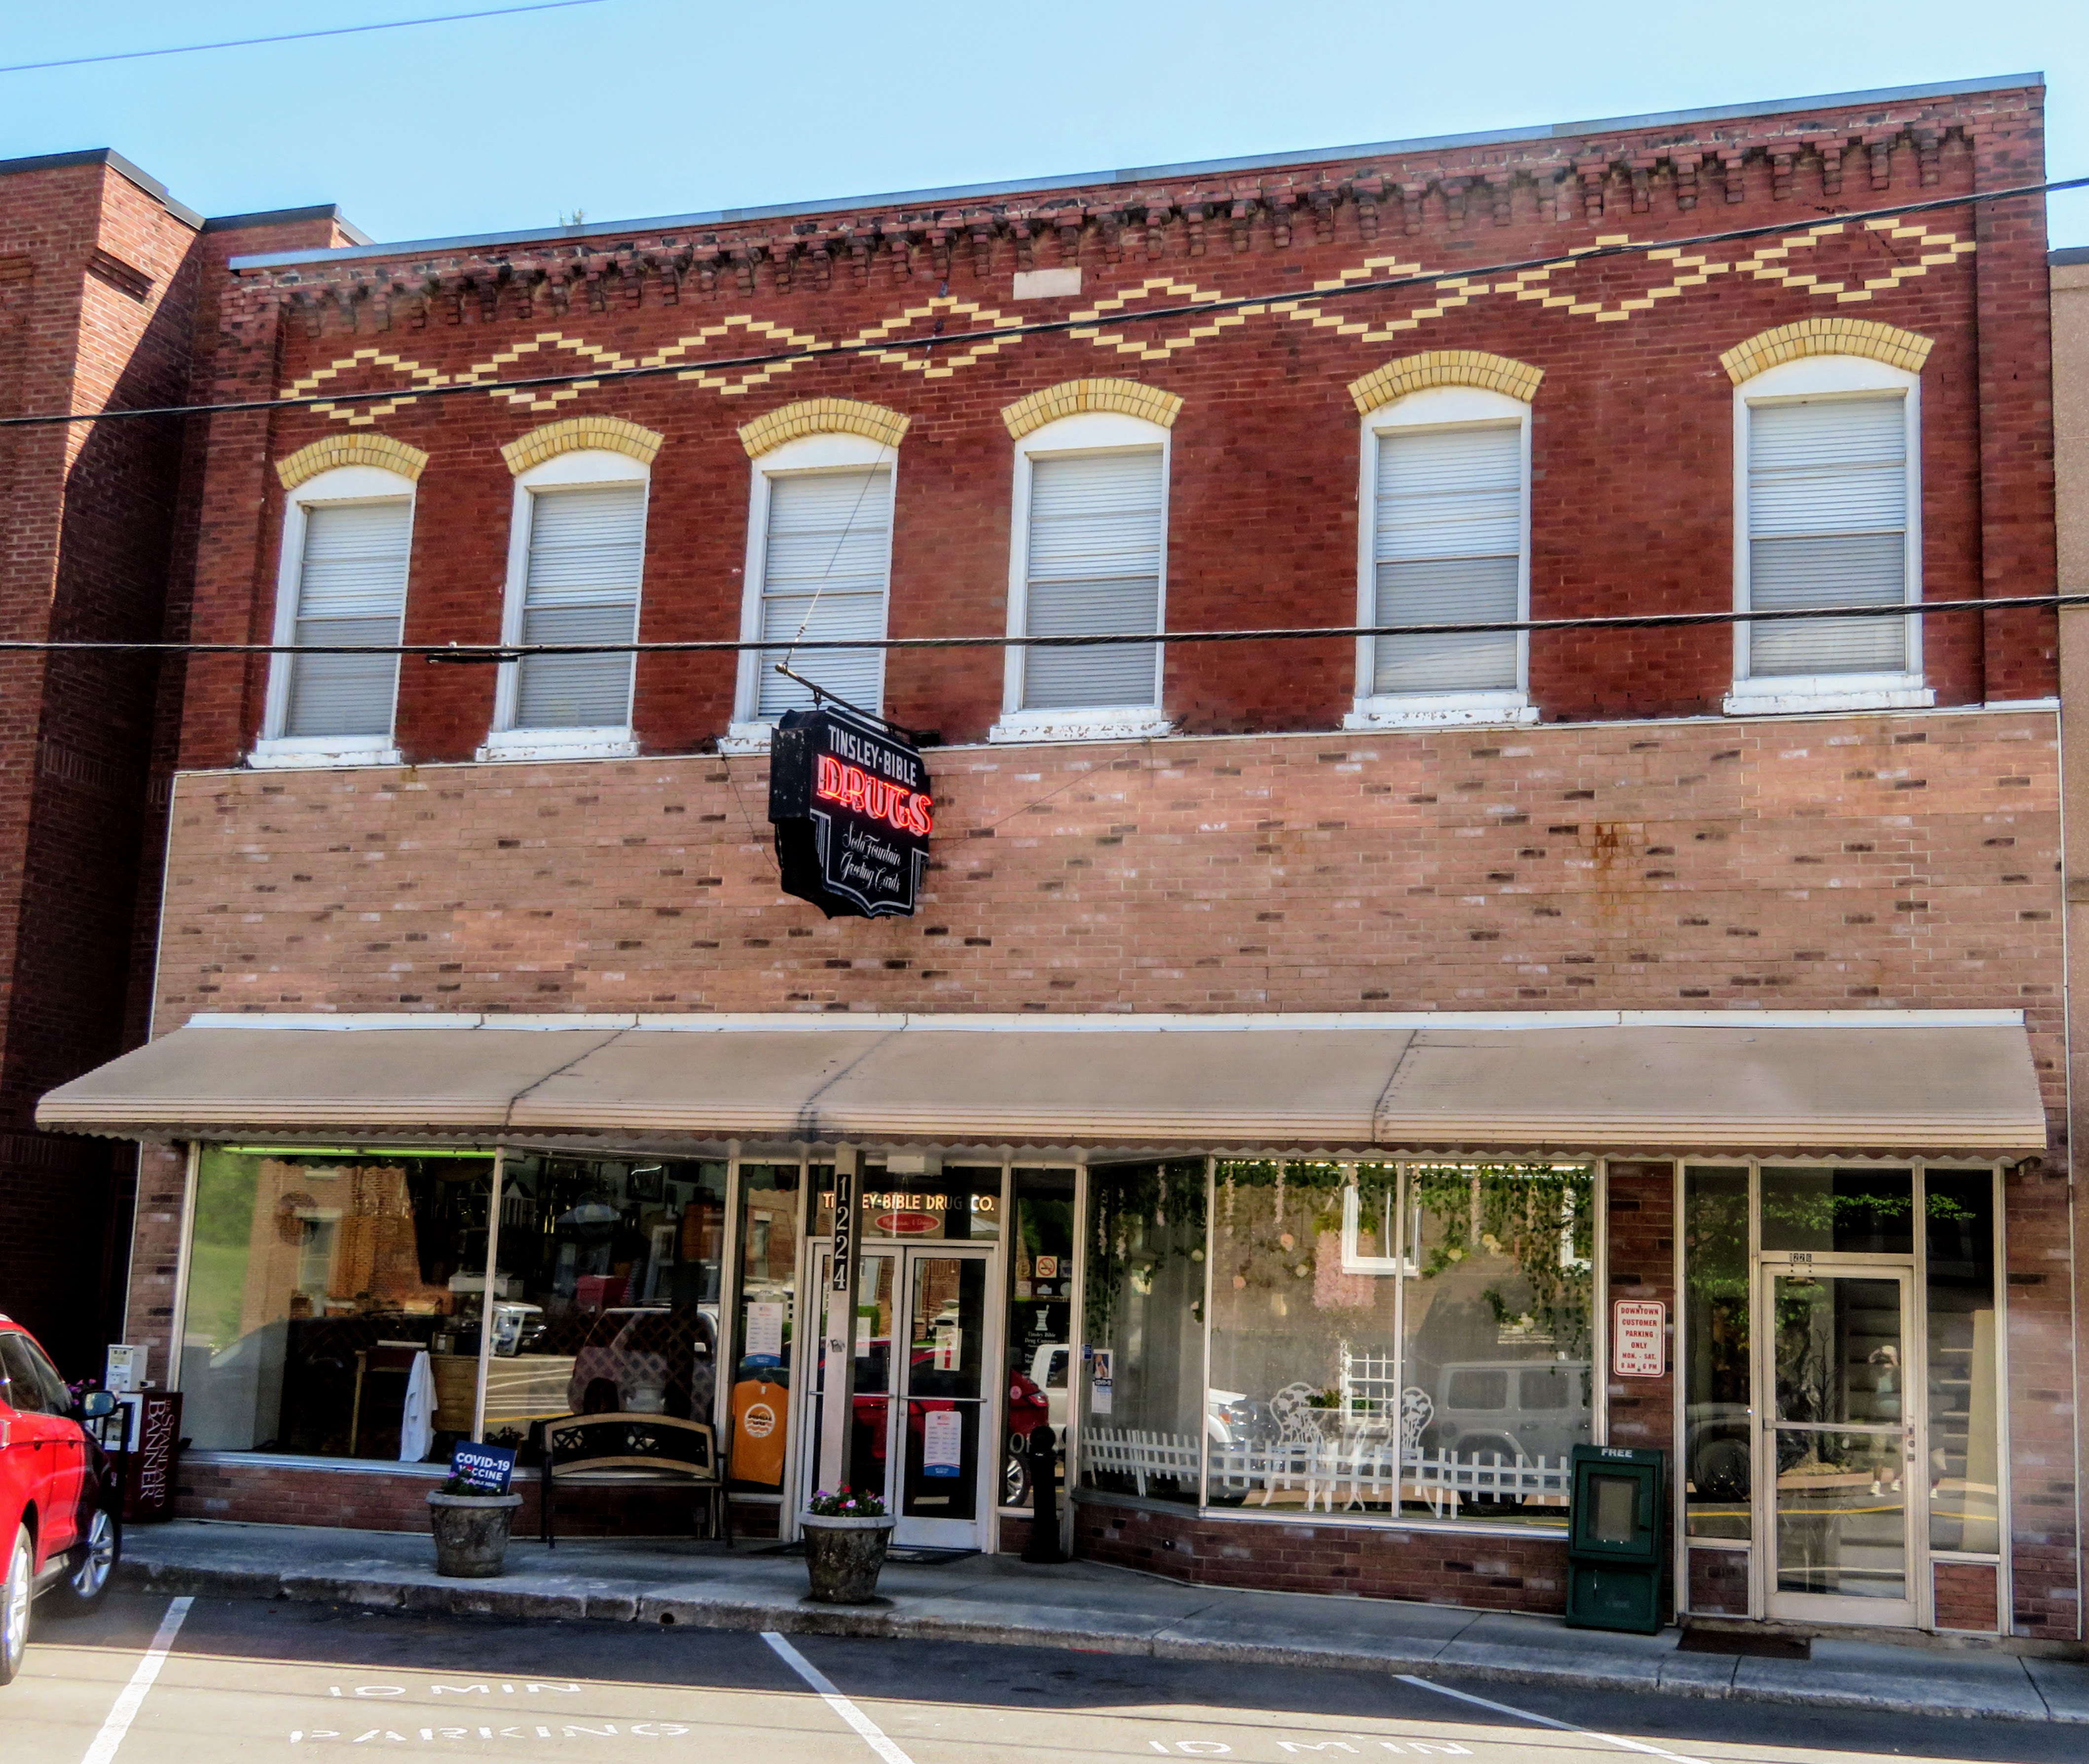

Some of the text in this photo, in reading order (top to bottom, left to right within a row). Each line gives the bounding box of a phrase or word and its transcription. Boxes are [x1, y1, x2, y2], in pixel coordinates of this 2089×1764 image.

[816, 754, 933, 837] DRUGS
[842, 821, 901, 866] Soda Fountain
[840, 851, 901, 893] Greeting Cards
[926, 1195, 962, 1210] DRUG
[970, 1195, 994, 1211] CO.
[833, 1176, 849, 1289] 1224
[140, 1399, 166, 1500] BANNER
[1601, 1448, 1632, 1458] FREE
[153, 1414, 175, 1507] STANDARD
[456, 1452, 510, 1471] COVID-19
[459, 1464, 504, 1481] VCCINE
[431, 1684, 582, 1694] MIN
[290, 1724, 690, 1743] PARKING
[1276, 1741, 1475, 1755] MIN
